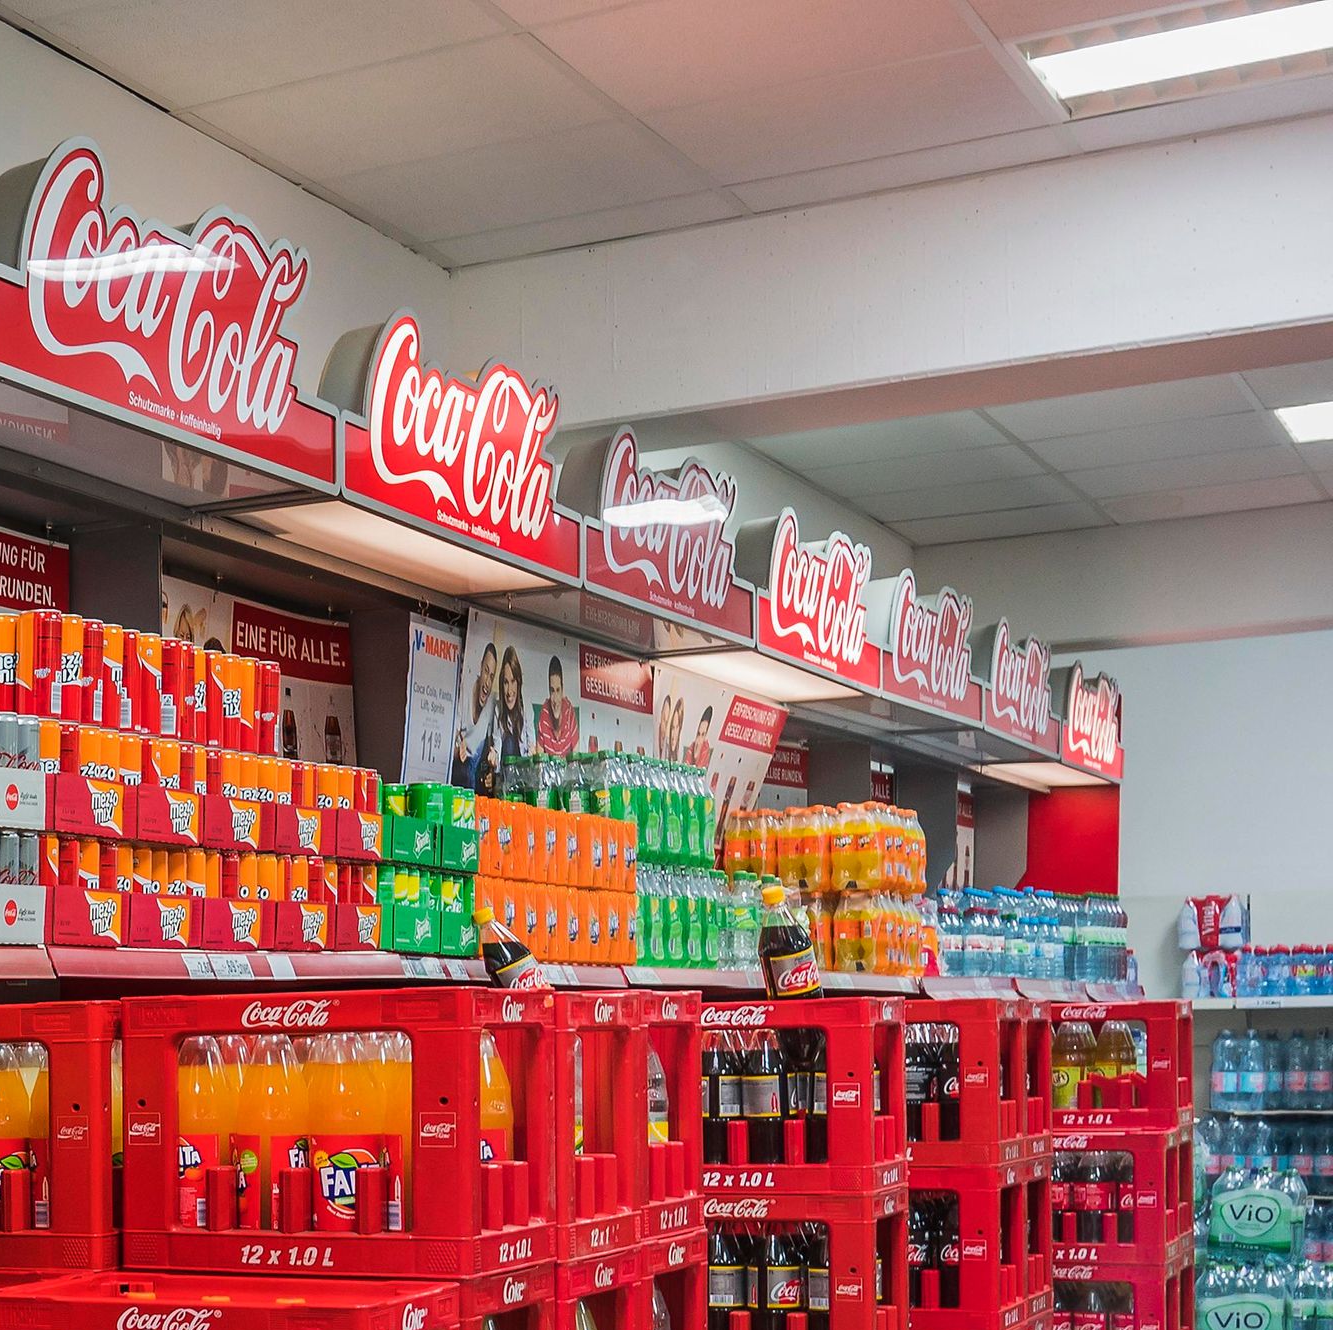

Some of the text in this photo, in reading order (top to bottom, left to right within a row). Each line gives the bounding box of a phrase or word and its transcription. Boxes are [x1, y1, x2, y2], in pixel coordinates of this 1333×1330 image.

[28, 156, 309, 435] Coca-Cola
[128, 390, 222, 440] Schutzmarke koffeinhaltig
[372, 324, 558, 540] Coca-Cola
[21, 546, 46, 574] FÜR
[0, 576, 56, 607] RUNDEN.
[771, 517, 869, 665] Coca-Cola
[236, 621, 346, 667] EINE FÜR ALLE.
[414, 628, 458, 663] V-MARKT
[893, 577, 972, 700] Coca-Cola
[991, 623, 1049, 735] Coca-Cola
[1069, 668, 1118, 765] Coca-Cola
[241, 1000, 332, 1028] Coca-Cola
[703, 1172, 774, 1186] 12 x 1.0 L
[1230, 1205, 1274, 1224] ViO
[1214, 1311, 1263, 1330] ViO
